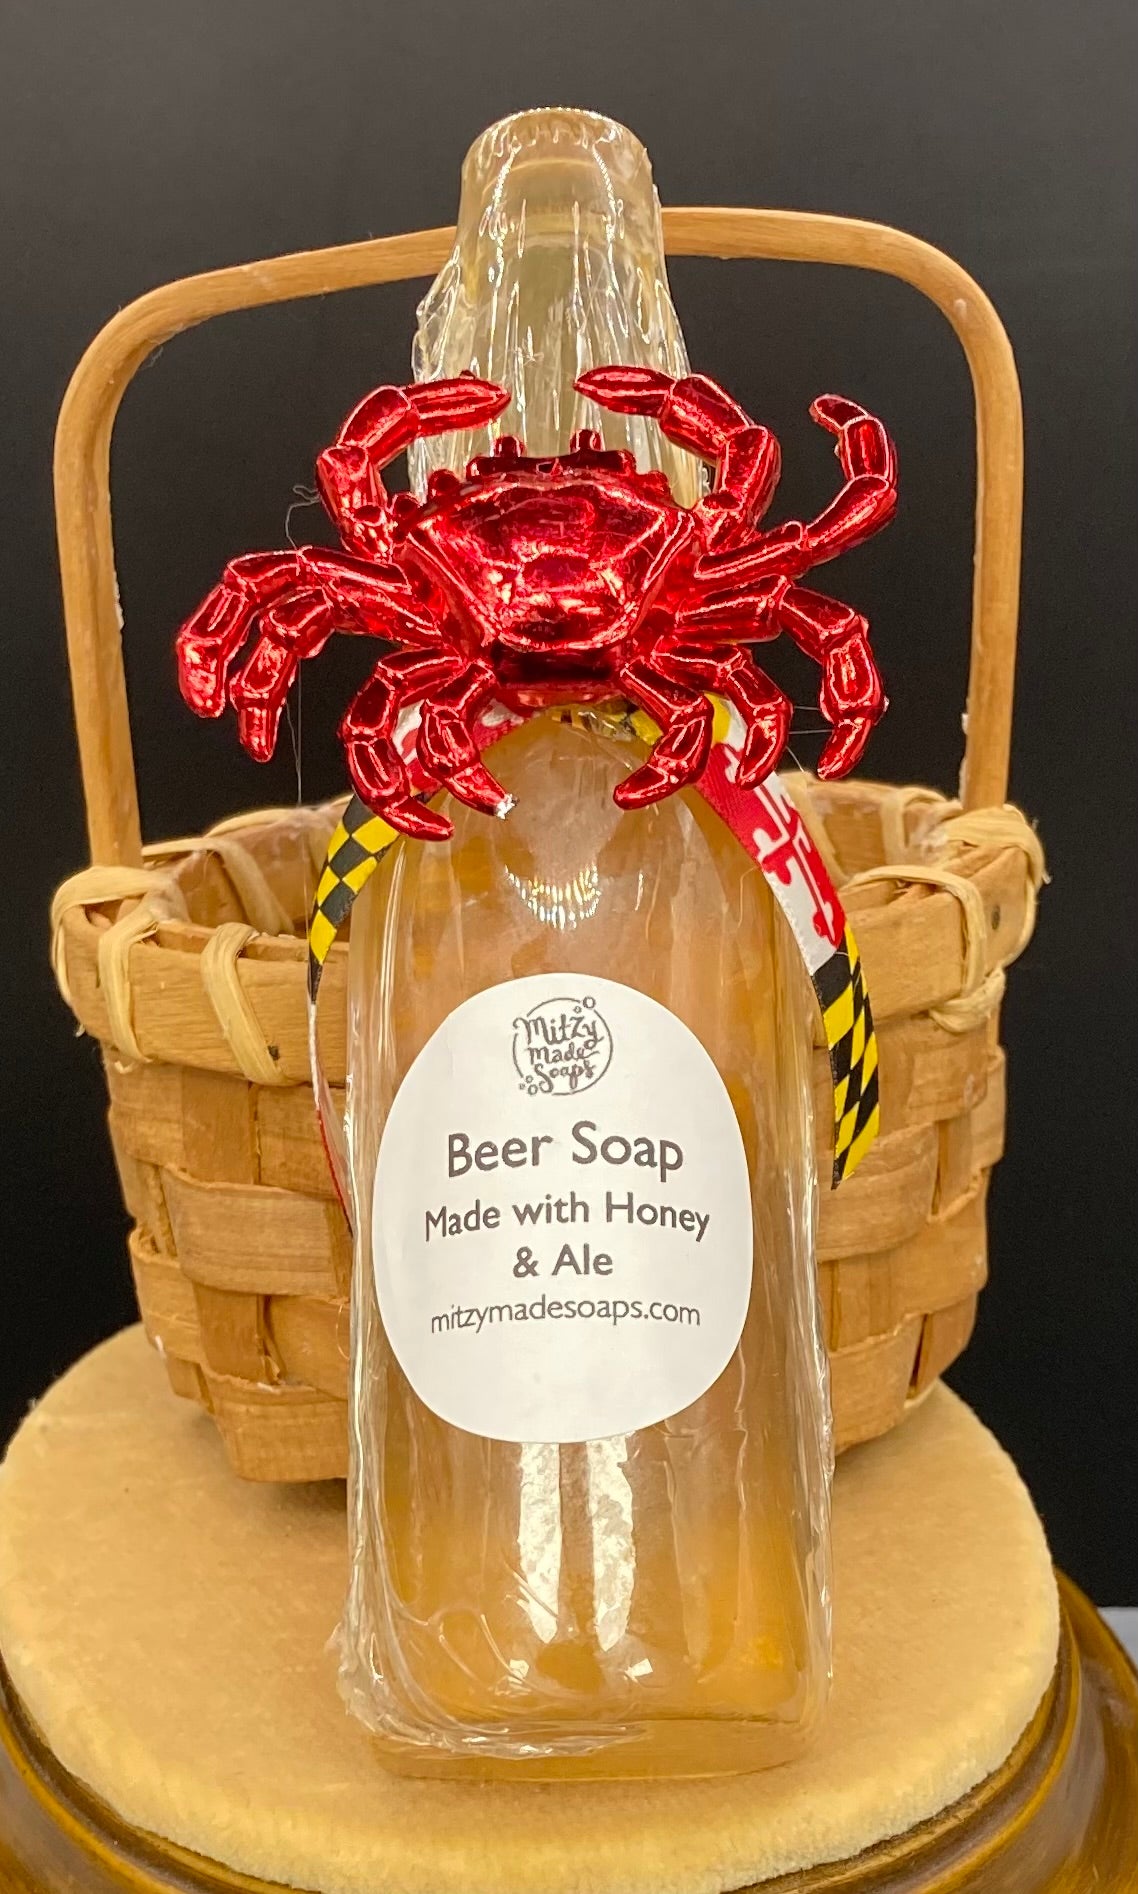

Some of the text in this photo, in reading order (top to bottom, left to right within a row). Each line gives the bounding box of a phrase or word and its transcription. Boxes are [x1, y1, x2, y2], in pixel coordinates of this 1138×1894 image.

[533, 1060, 597, 1093] Soaps
[448, 1119, 684, 1184] Beer Soap
[425, 1190, 710, 1243] Made with Honey
[512, 1242, 614, 1279] & Ale
[431, 1293, 701, 1334] mitzymadesoaps.com
